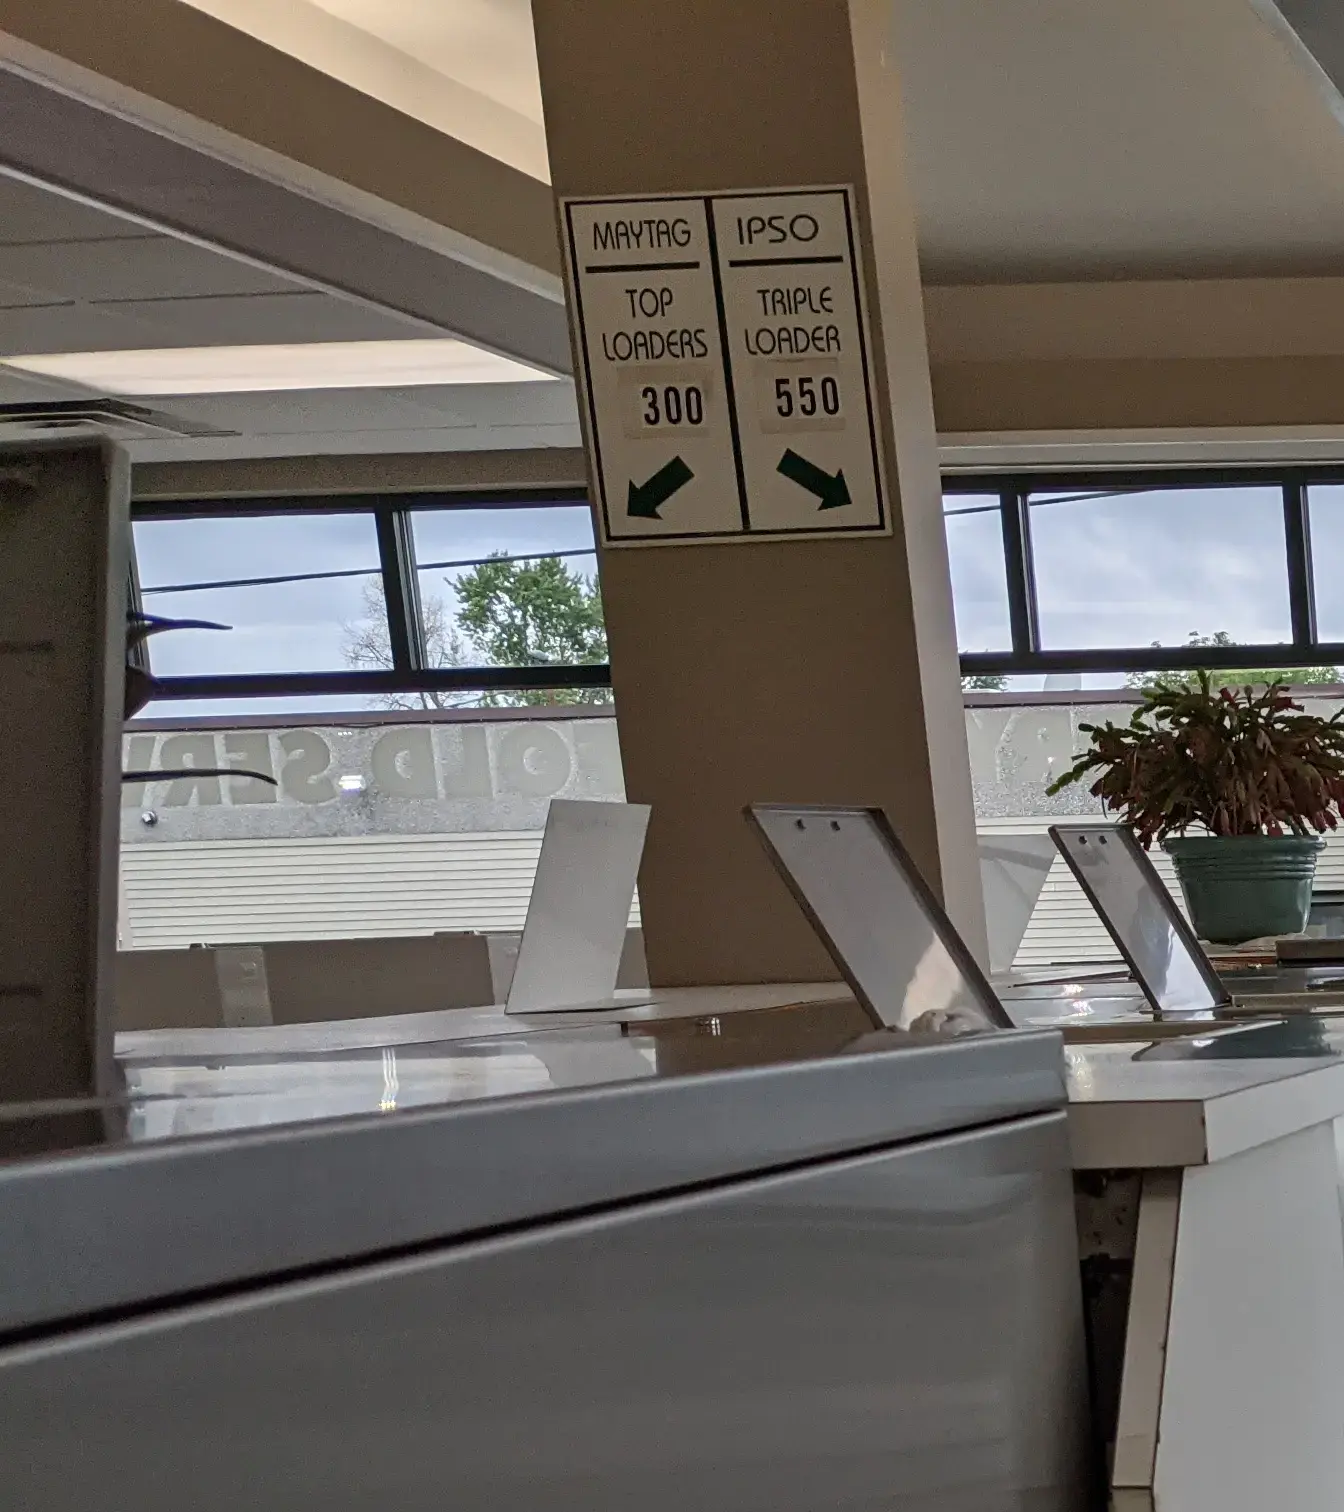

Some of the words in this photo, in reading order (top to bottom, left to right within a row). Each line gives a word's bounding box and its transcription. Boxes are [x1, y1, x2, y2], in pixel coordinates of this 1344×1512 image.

[593, 217, 692, 250] MAYTAG
[736, 214, 819, 245] IPSO
[625, 286, 674, 319] TOP
[756, 285, 834, 316] TRIPLE
[602, 328, 709, 362] LOADERS
[744, 324, 842, 356] LOADER
[641, 385, 704, 426] 300
[774, 375, 840, 418] 550
